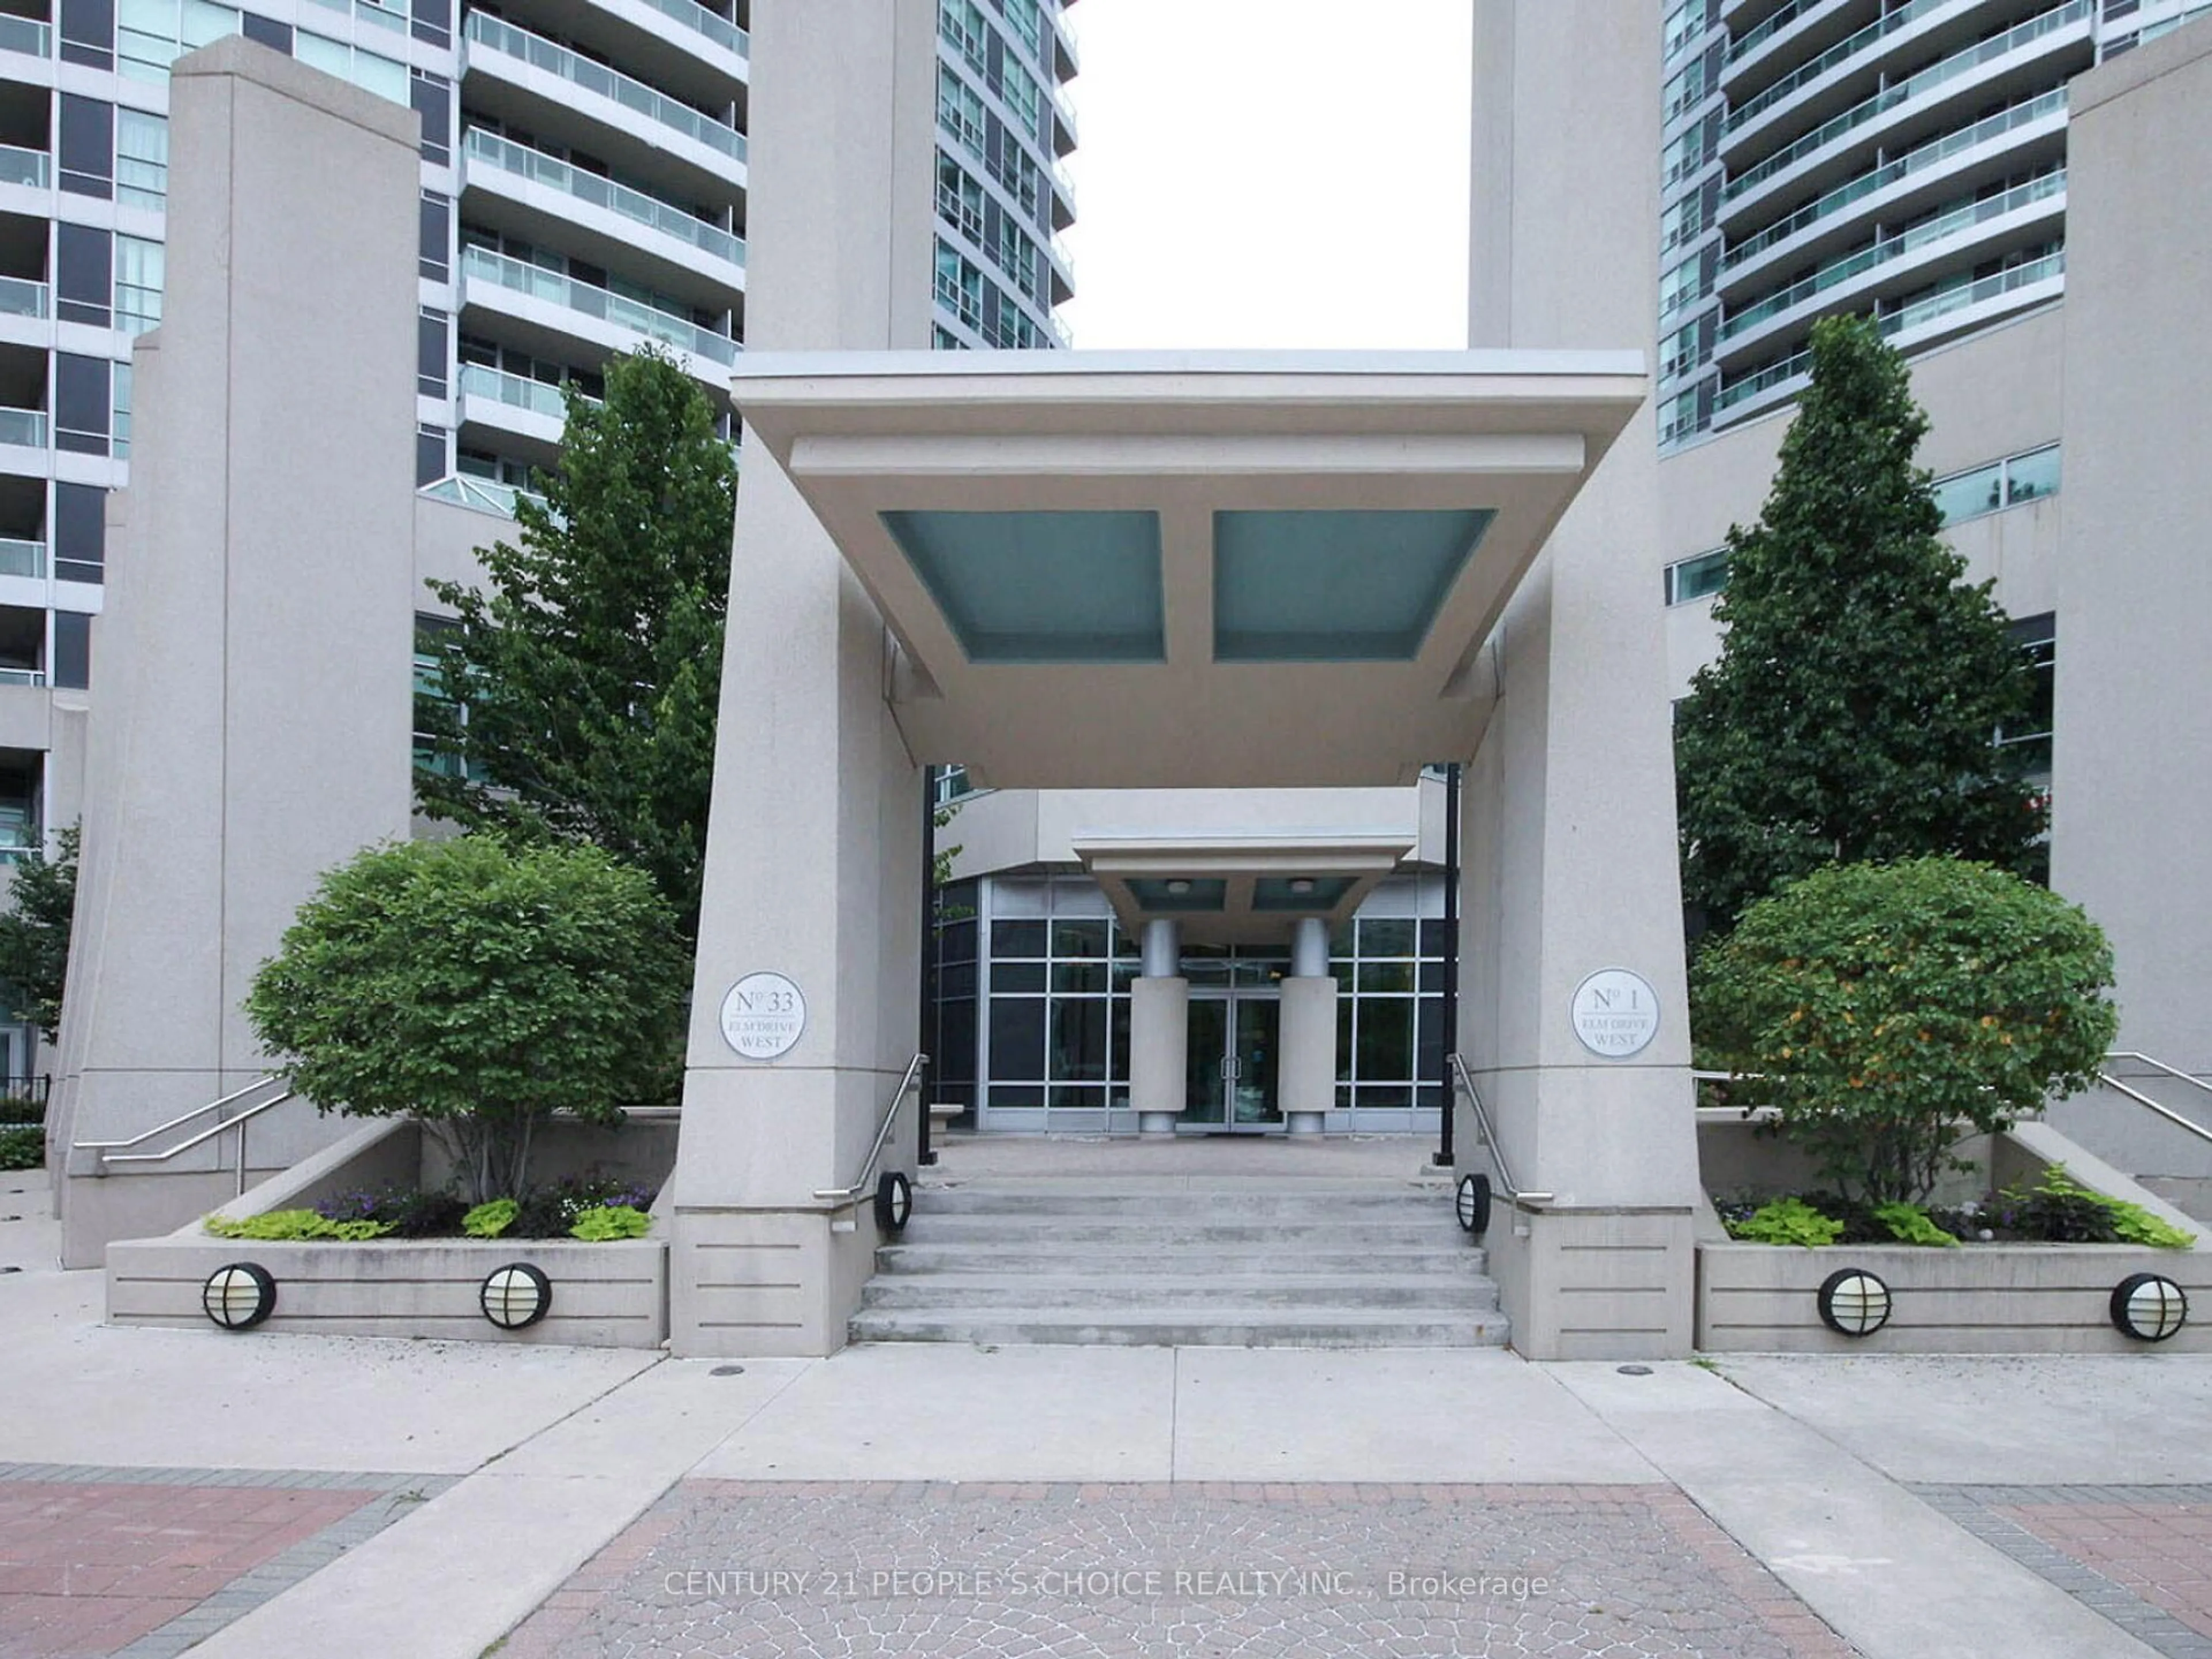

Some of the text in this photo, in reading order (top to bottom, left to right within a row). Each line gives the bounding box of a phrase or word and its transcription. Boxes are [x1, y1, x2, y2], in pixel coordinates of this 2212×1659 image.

[767, 991, 793, 1012] 33
[1631, 989, 1637, 1010] 1
[741, 1036, 782, 1048] WEST
[1594, 1033, 1638, 1046] WEST
